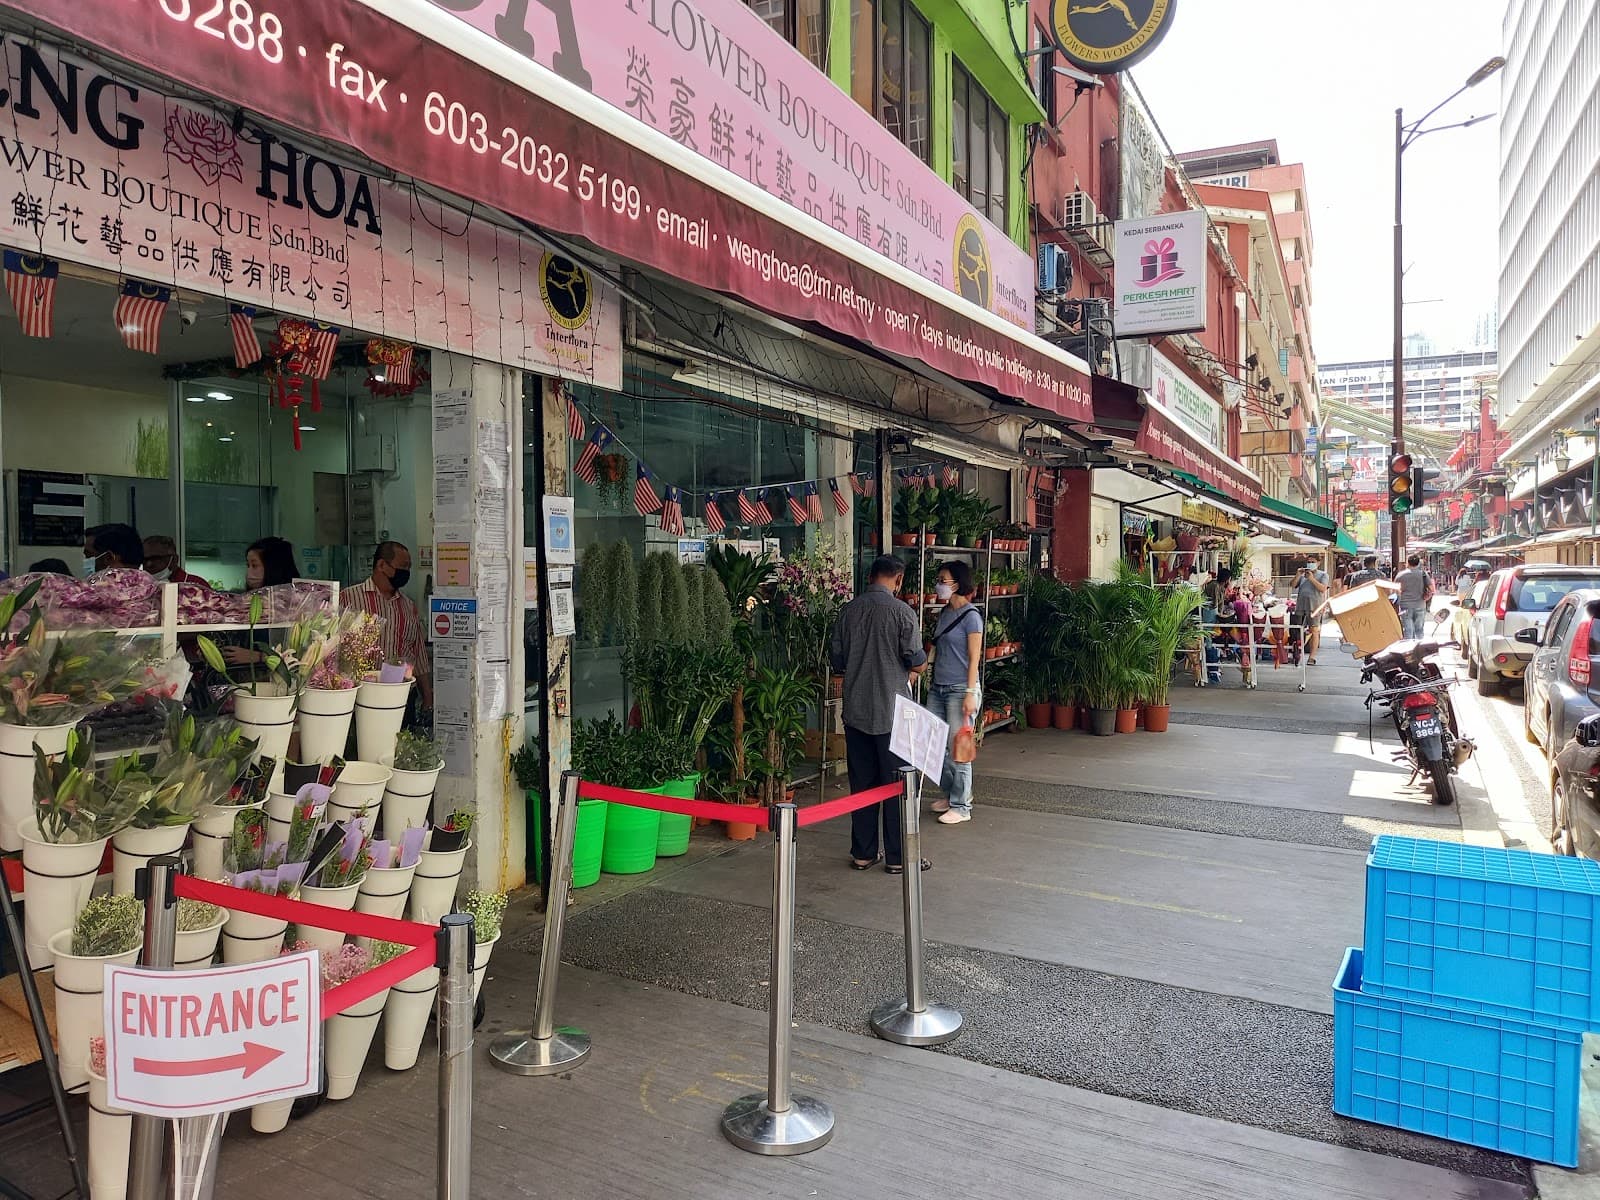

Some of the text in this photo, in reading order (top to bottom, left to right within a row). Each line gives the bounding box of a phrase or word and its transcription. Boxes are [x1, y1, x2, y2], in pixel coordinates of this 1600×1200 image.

[1058, 1, 1165, 61] FLOWERS WORLD WIDE
[0, 40, 382, 236] NG HOA
[625, 0, 771, 112] LOWER
[778, 79, 891, 201] BOUTIQUE
[896, 179, 945, 241] Sdn.Bhd.
[100, 167, 262, 241] BOUTIQUE
[325, 43, 388, 112] fax
[424, 91, 569, 192] 603-2032
[578, 164, 641, 220] 5199
[657, 207, 708, 250] email
[726, 234, 875, 324] wenghoa@tm.net.my
[884, 307, 910, 333] open
[912, 313, 920, 336] 7
[920, 319, 943, 349] days
[946, 330, 983, 366] including
[984, 346, 1004, 371] public
[1005, 354, 1032, 385] holidays
[1036, 369, 1051, 391] 8:30
[1123, 222, 1184, 237] KEDAI SERBANEKA
[11, 191, 351, 311] 鮮花藝品供應有限公司
[995, 274, 1027, 313] Interflora
[1123, 290, 1168, 303] PERKESA
[1169, 286, 1197, 298] MART
[545, 327, 588, 349] Interflora
[440, 602, 469, 611] NOTICE
[121, 979, 299, 1039] ENTRANCE
